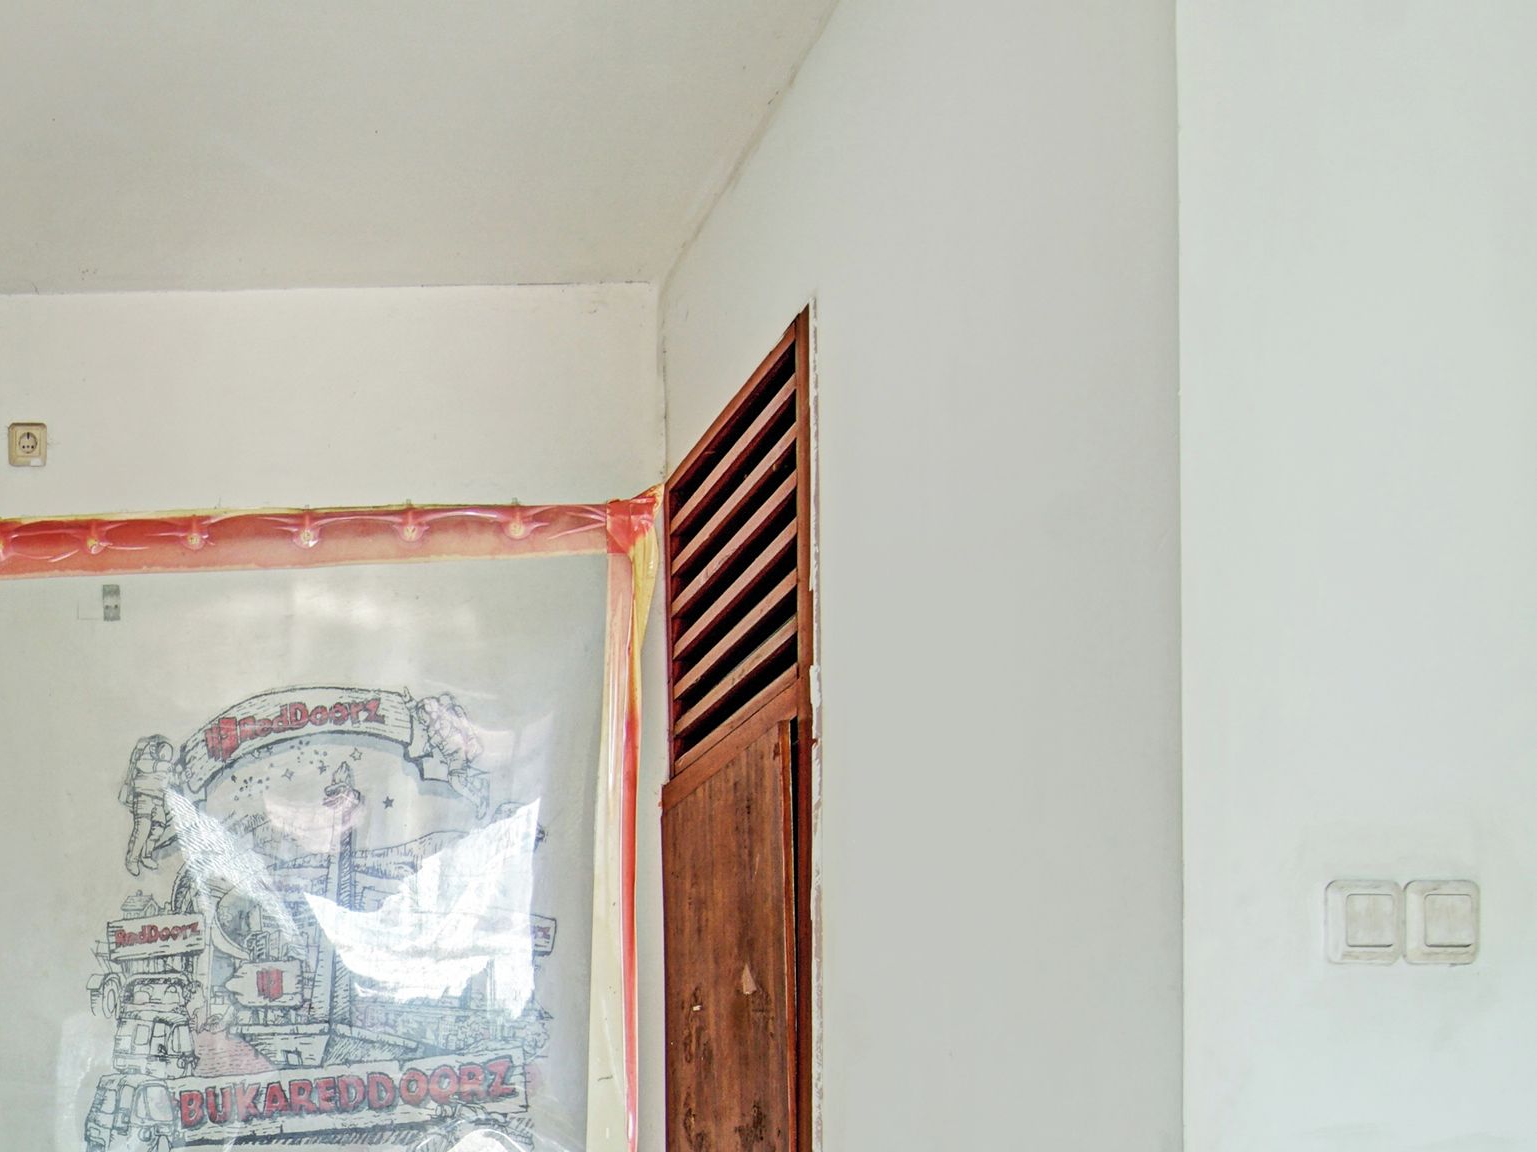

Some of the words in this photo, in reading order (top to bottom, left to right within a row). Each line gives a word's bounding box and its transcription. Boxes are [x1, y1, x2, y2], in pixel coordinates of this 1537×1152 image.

[239, 697, 385, 741] RedDoorz
[115, 921, 201, 947] RedDoorz
[179, 1054, 519, 1129] BUKAREDDOORZ
